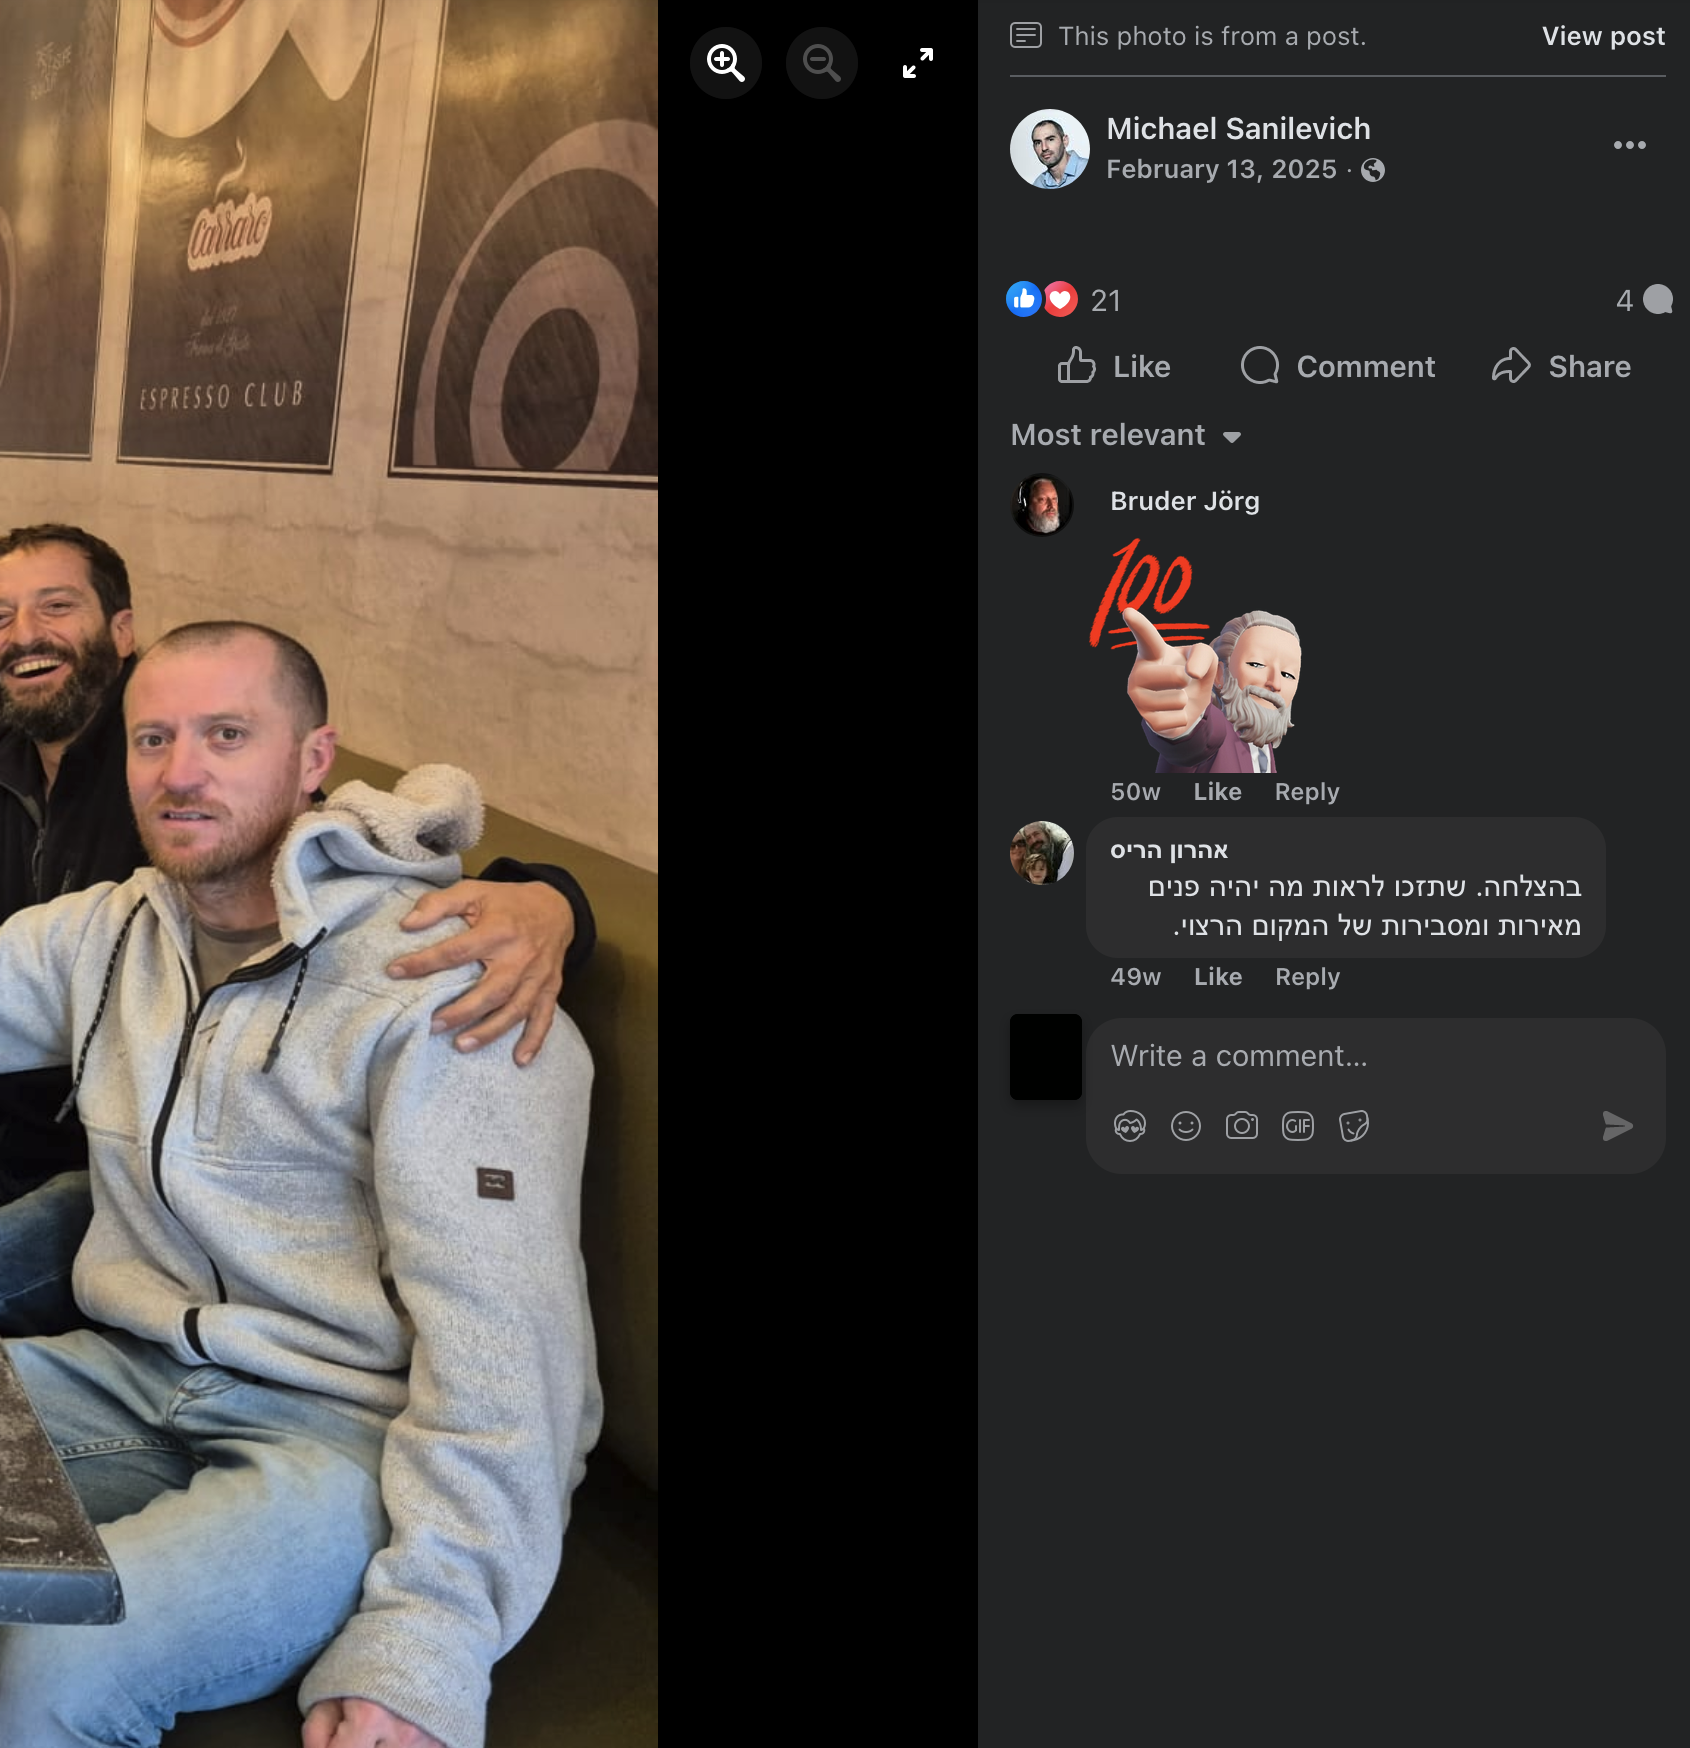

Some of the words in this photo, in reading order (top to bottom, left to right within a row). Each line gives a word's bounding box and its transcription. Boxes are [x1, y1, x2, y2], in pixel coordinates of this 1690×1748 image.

[190, 204, 267, 259] Carraro
[140, 384, 230, 411] ESPRESSO
[244, 380, 303, 408] CLUB
